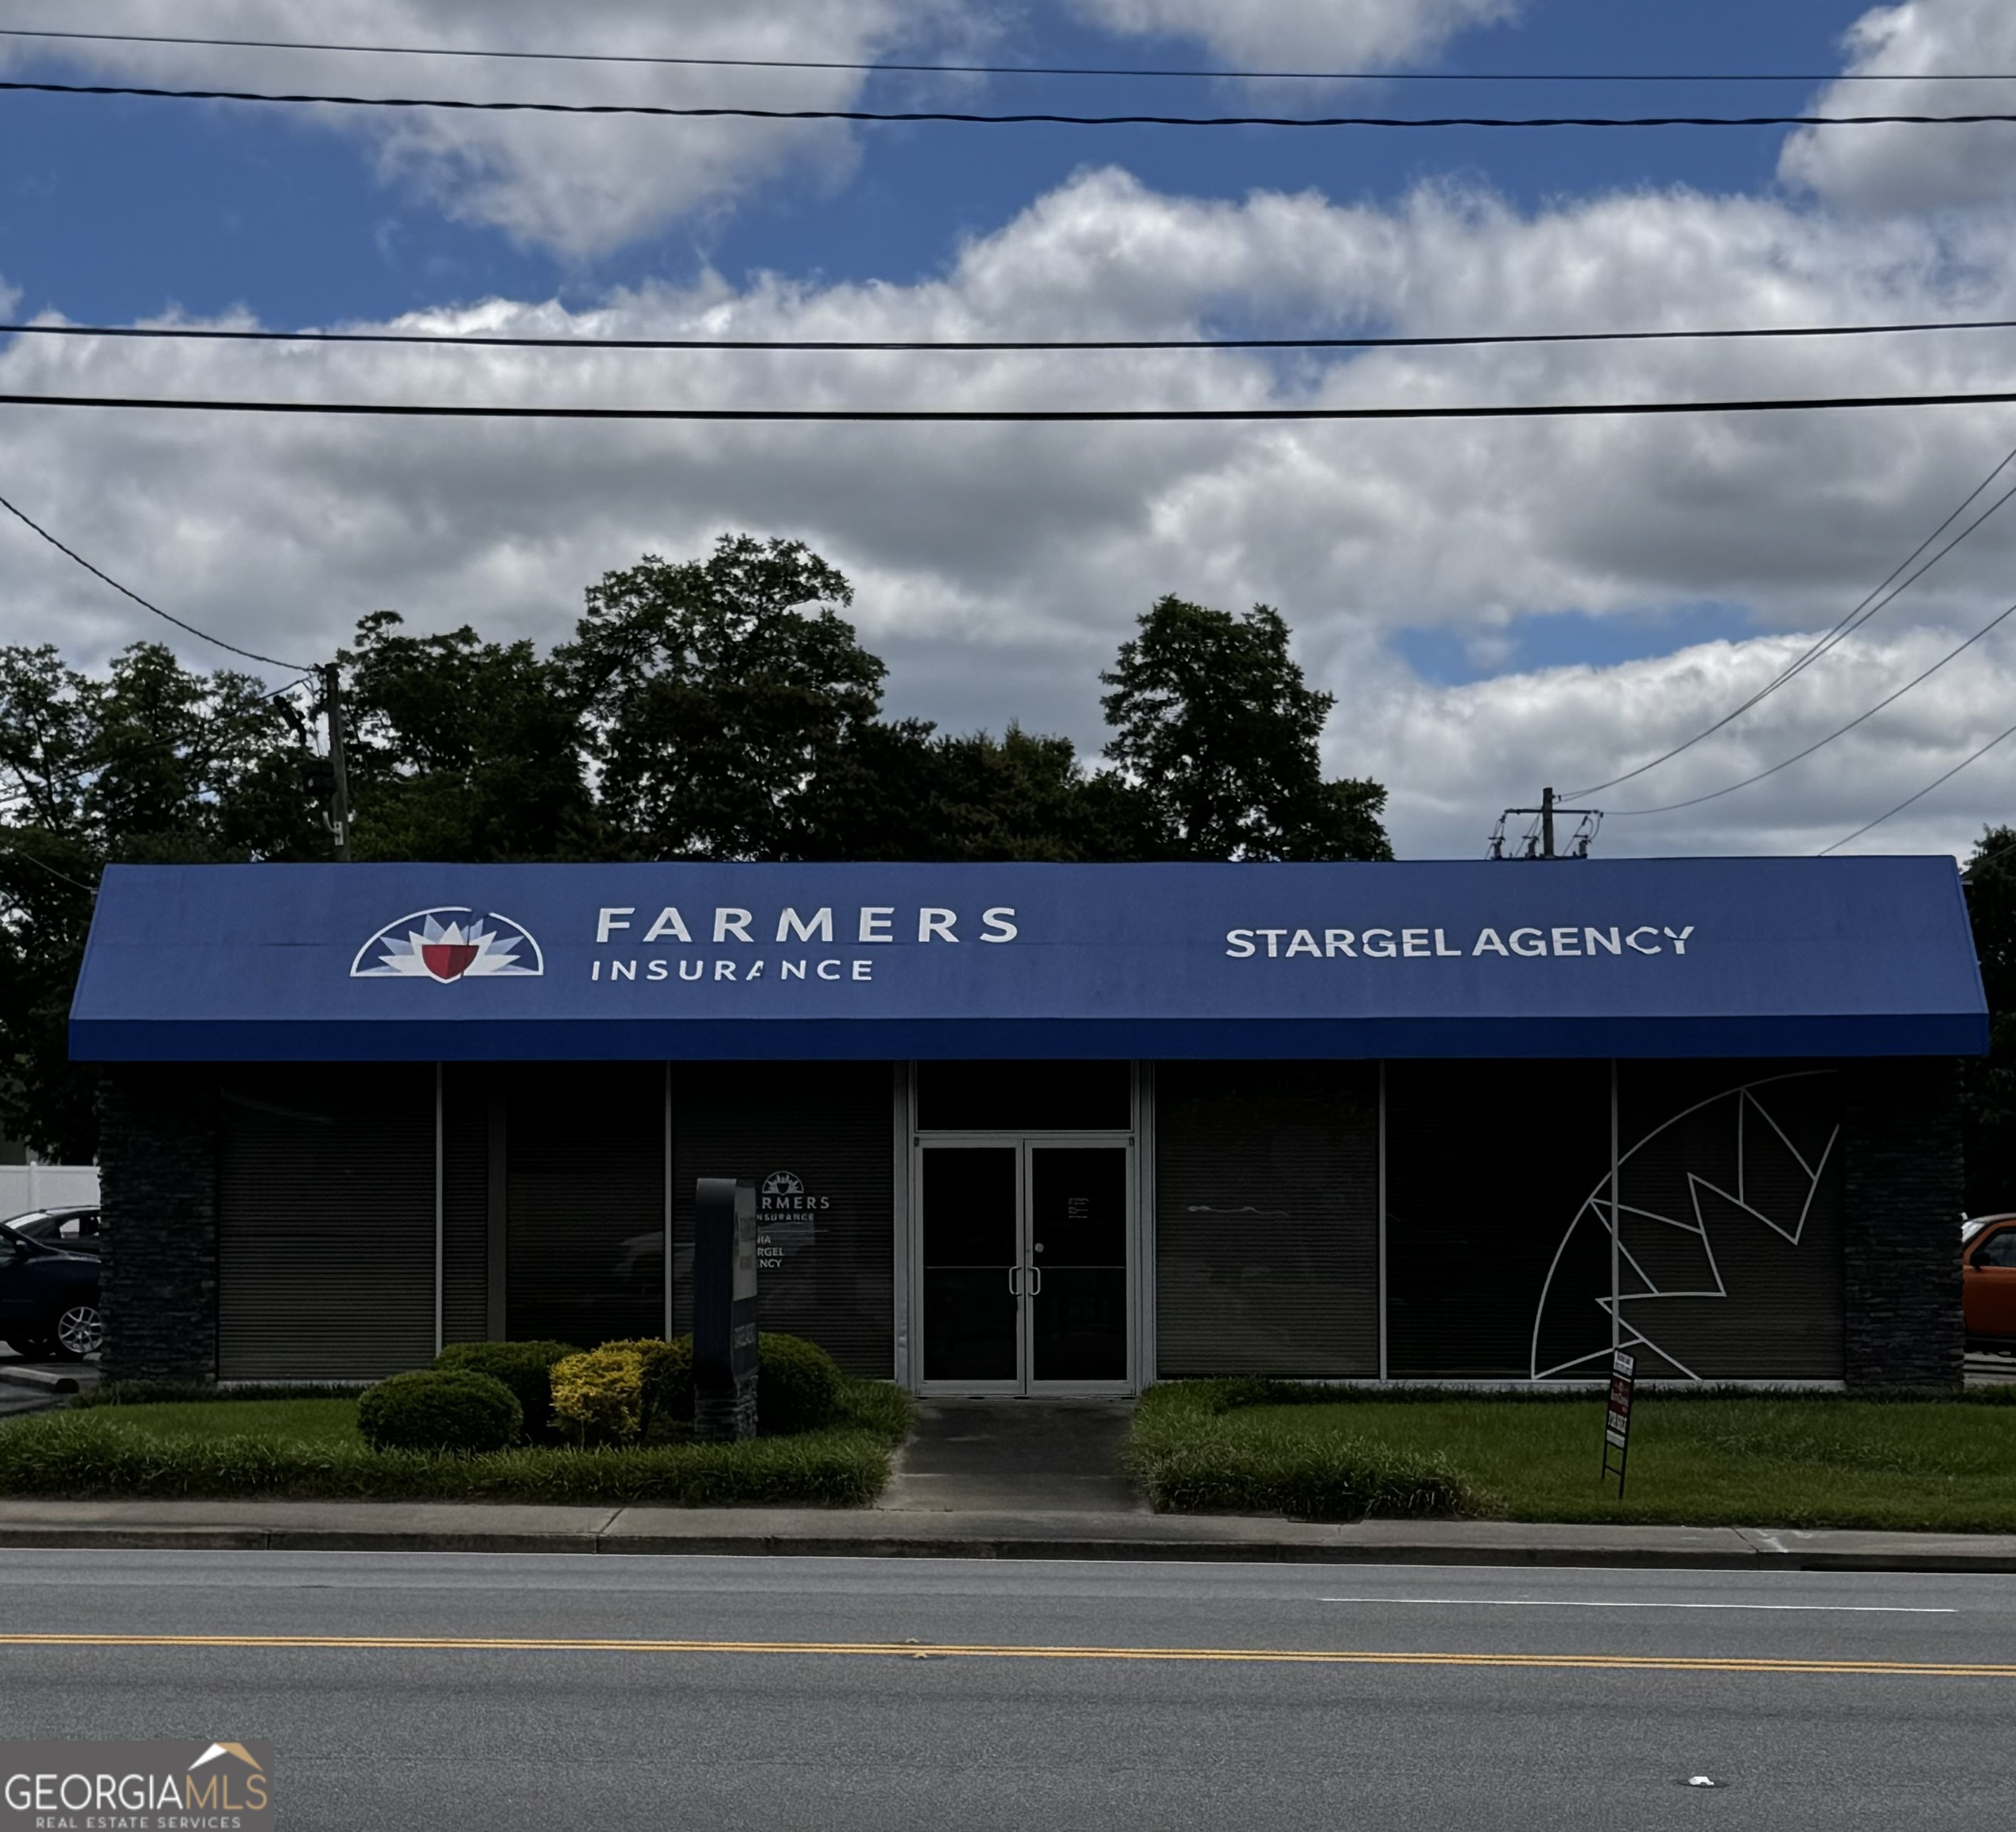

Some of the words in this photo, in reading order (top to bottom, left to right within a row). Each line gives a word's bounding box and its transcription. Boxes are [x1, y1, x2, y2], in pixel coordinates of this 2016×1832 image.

[596, 906, 1018, 944] FARMERS
[1226, 927, 1462, 957] STARGEL
[1471, 926, 1696, 957] AGENCY
[591, 958, 873, 982] INSURANCE
[756, 1196, 830, 1209] RMERS
[757, 1247, 786, 1256] RGEL
[757, 1258, 783, 1268] NCY
